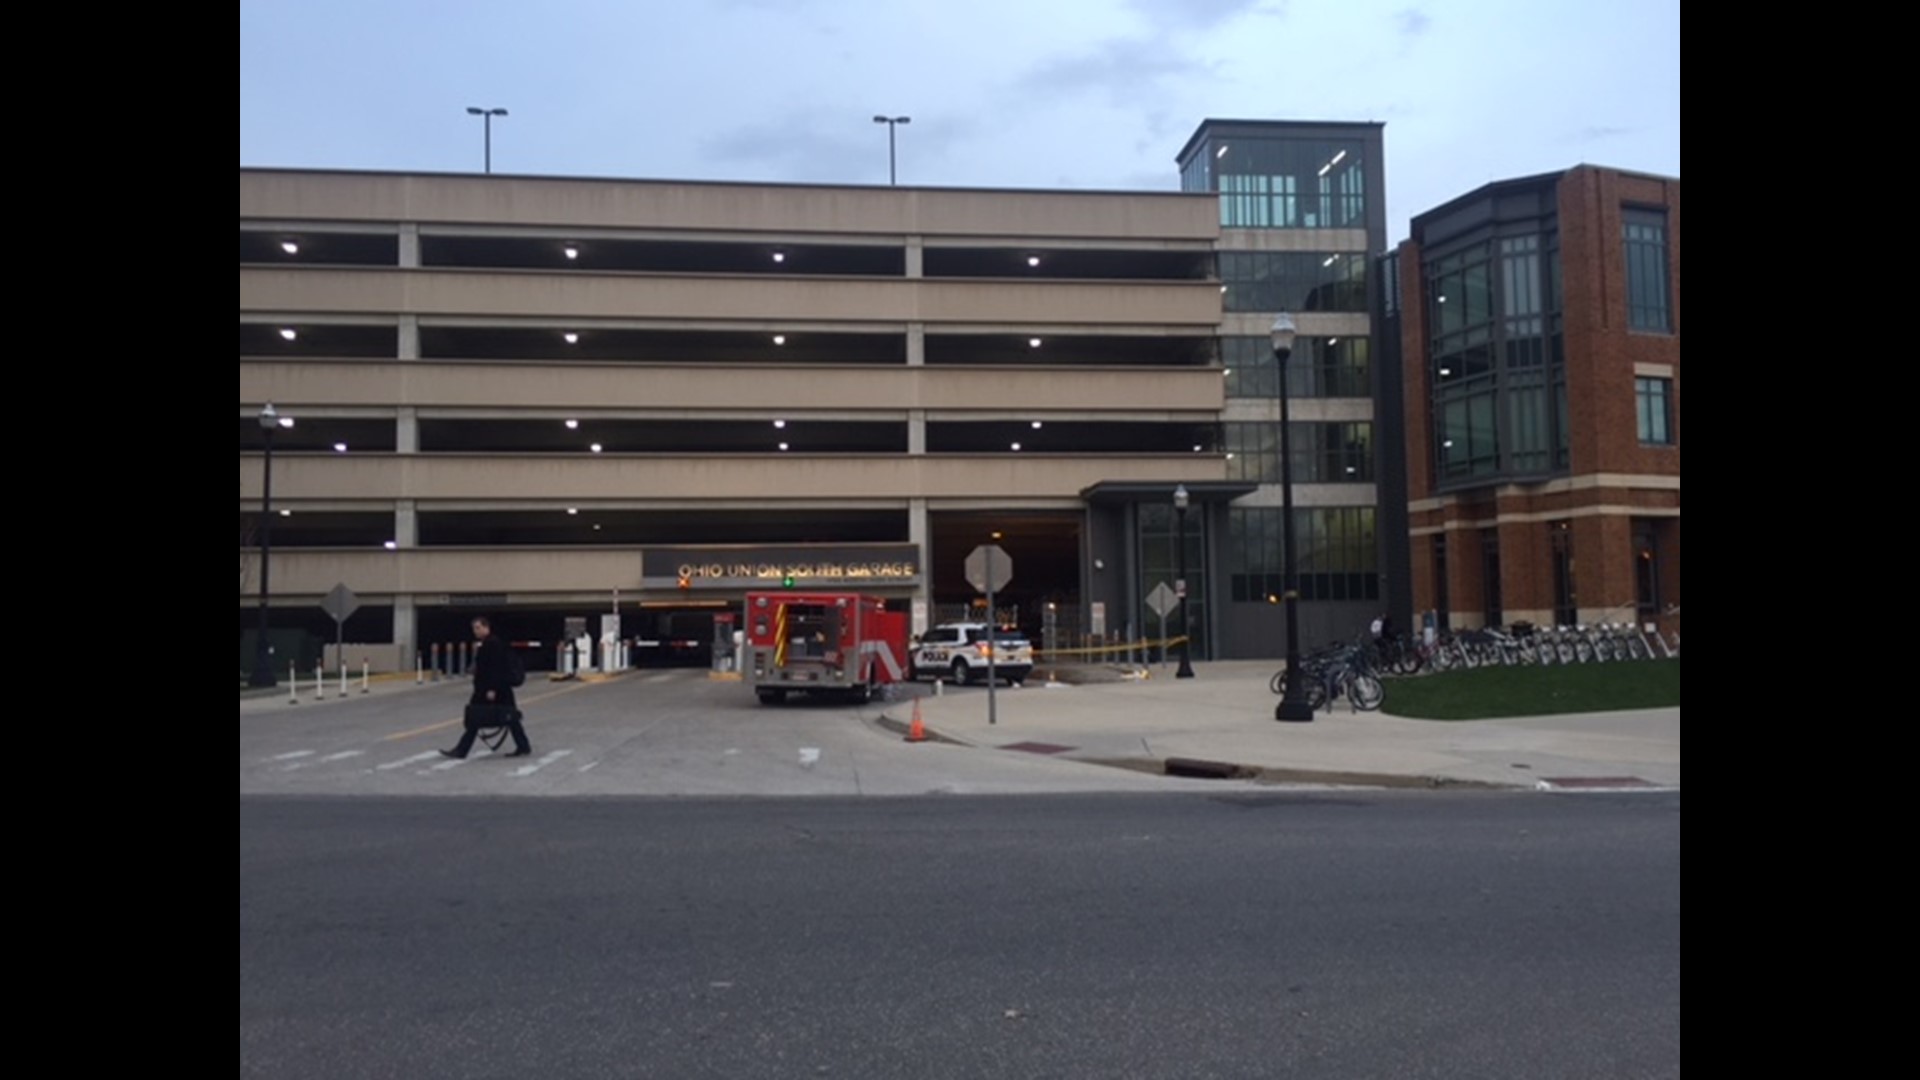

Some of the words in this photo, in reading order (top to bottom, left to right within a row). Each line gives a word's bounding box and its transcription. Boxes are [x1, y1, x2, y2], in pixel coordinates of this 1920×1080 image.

[678, 563, 723, 578] OHIO
[727, 563, 782, 578] UNION
[786, 562, 842, 577] SOUTH
[846, 561, 914, 577] GARAGE
[922, 650, 949, 662] POLICE
